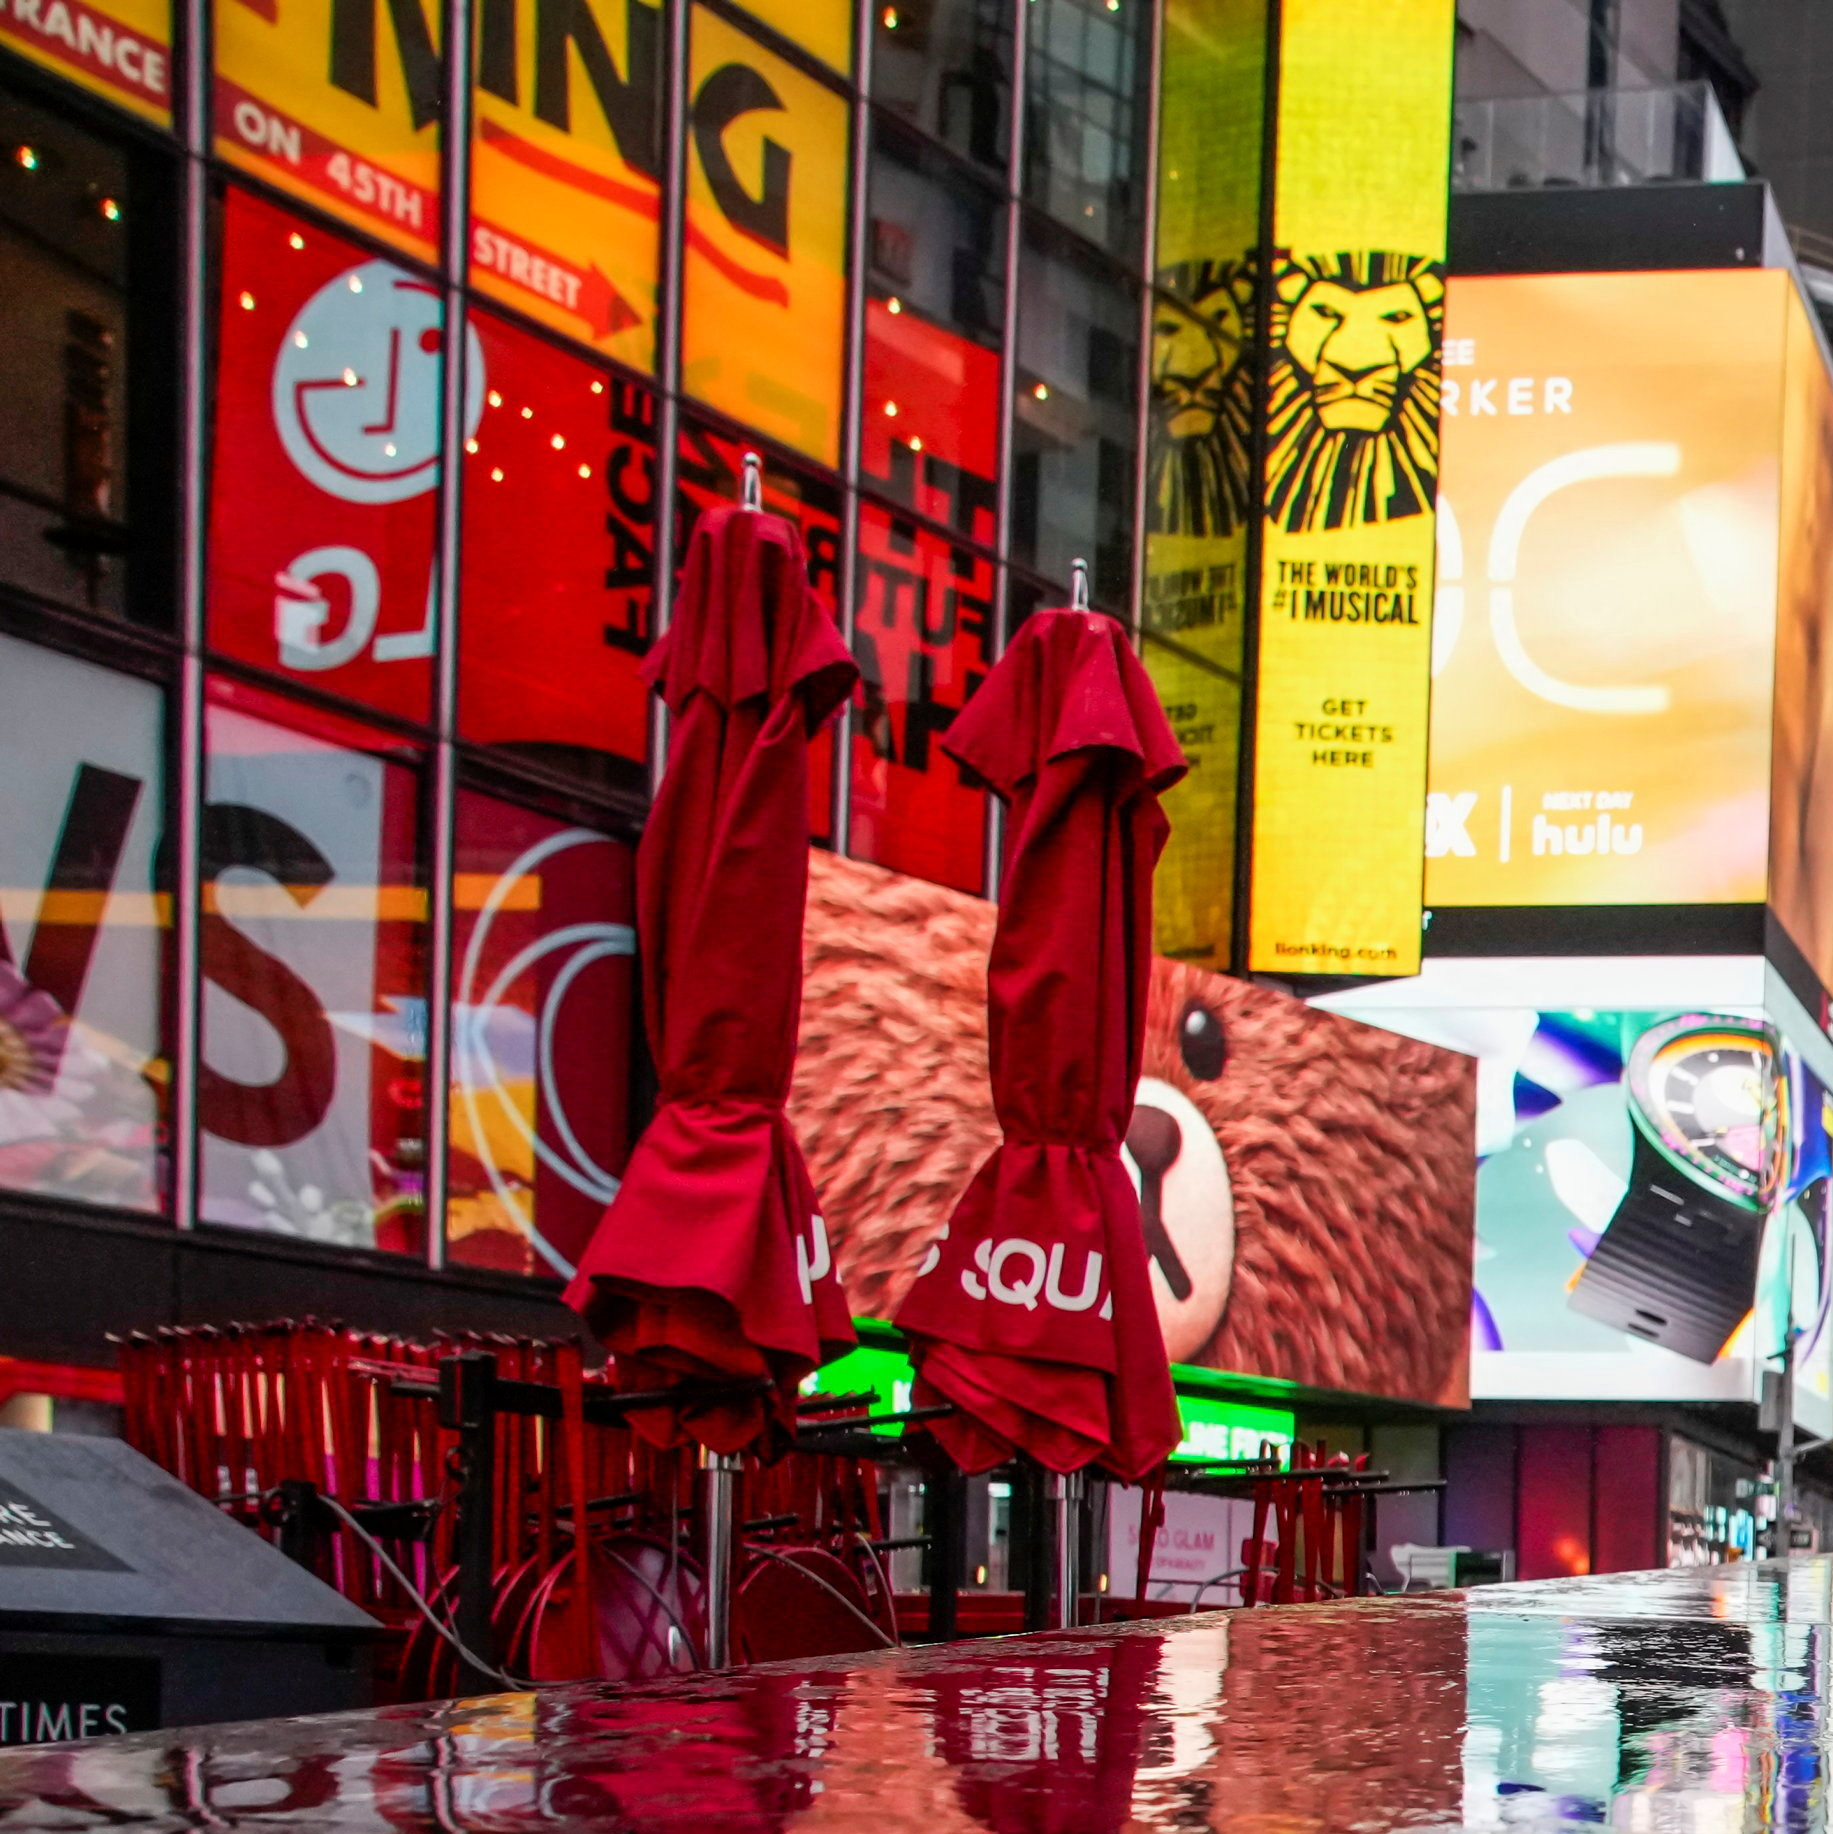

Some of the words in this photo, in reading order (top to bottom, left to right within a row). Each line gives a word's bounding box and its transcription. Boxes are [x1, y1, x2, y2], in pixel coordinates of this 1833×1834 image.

[0, 0, 167, 93] RANCE
[233, 101, 301, 165] ON
[326, 152, 423, 230] 45TH
[474, 229, 583, 313] STREET
[1277, 560, 1317, 586] THE
[1324, 562, 1419, 590] WORLD'S
[1303, 589, 1420, 625] MUSICAL
[1321, 698, 1369, 717] GET
[1294, 722, 1395, 743] TICKETS
[1311, 750, 1376, 769] HERE
[1532, 812, 1644, 857] hulu
